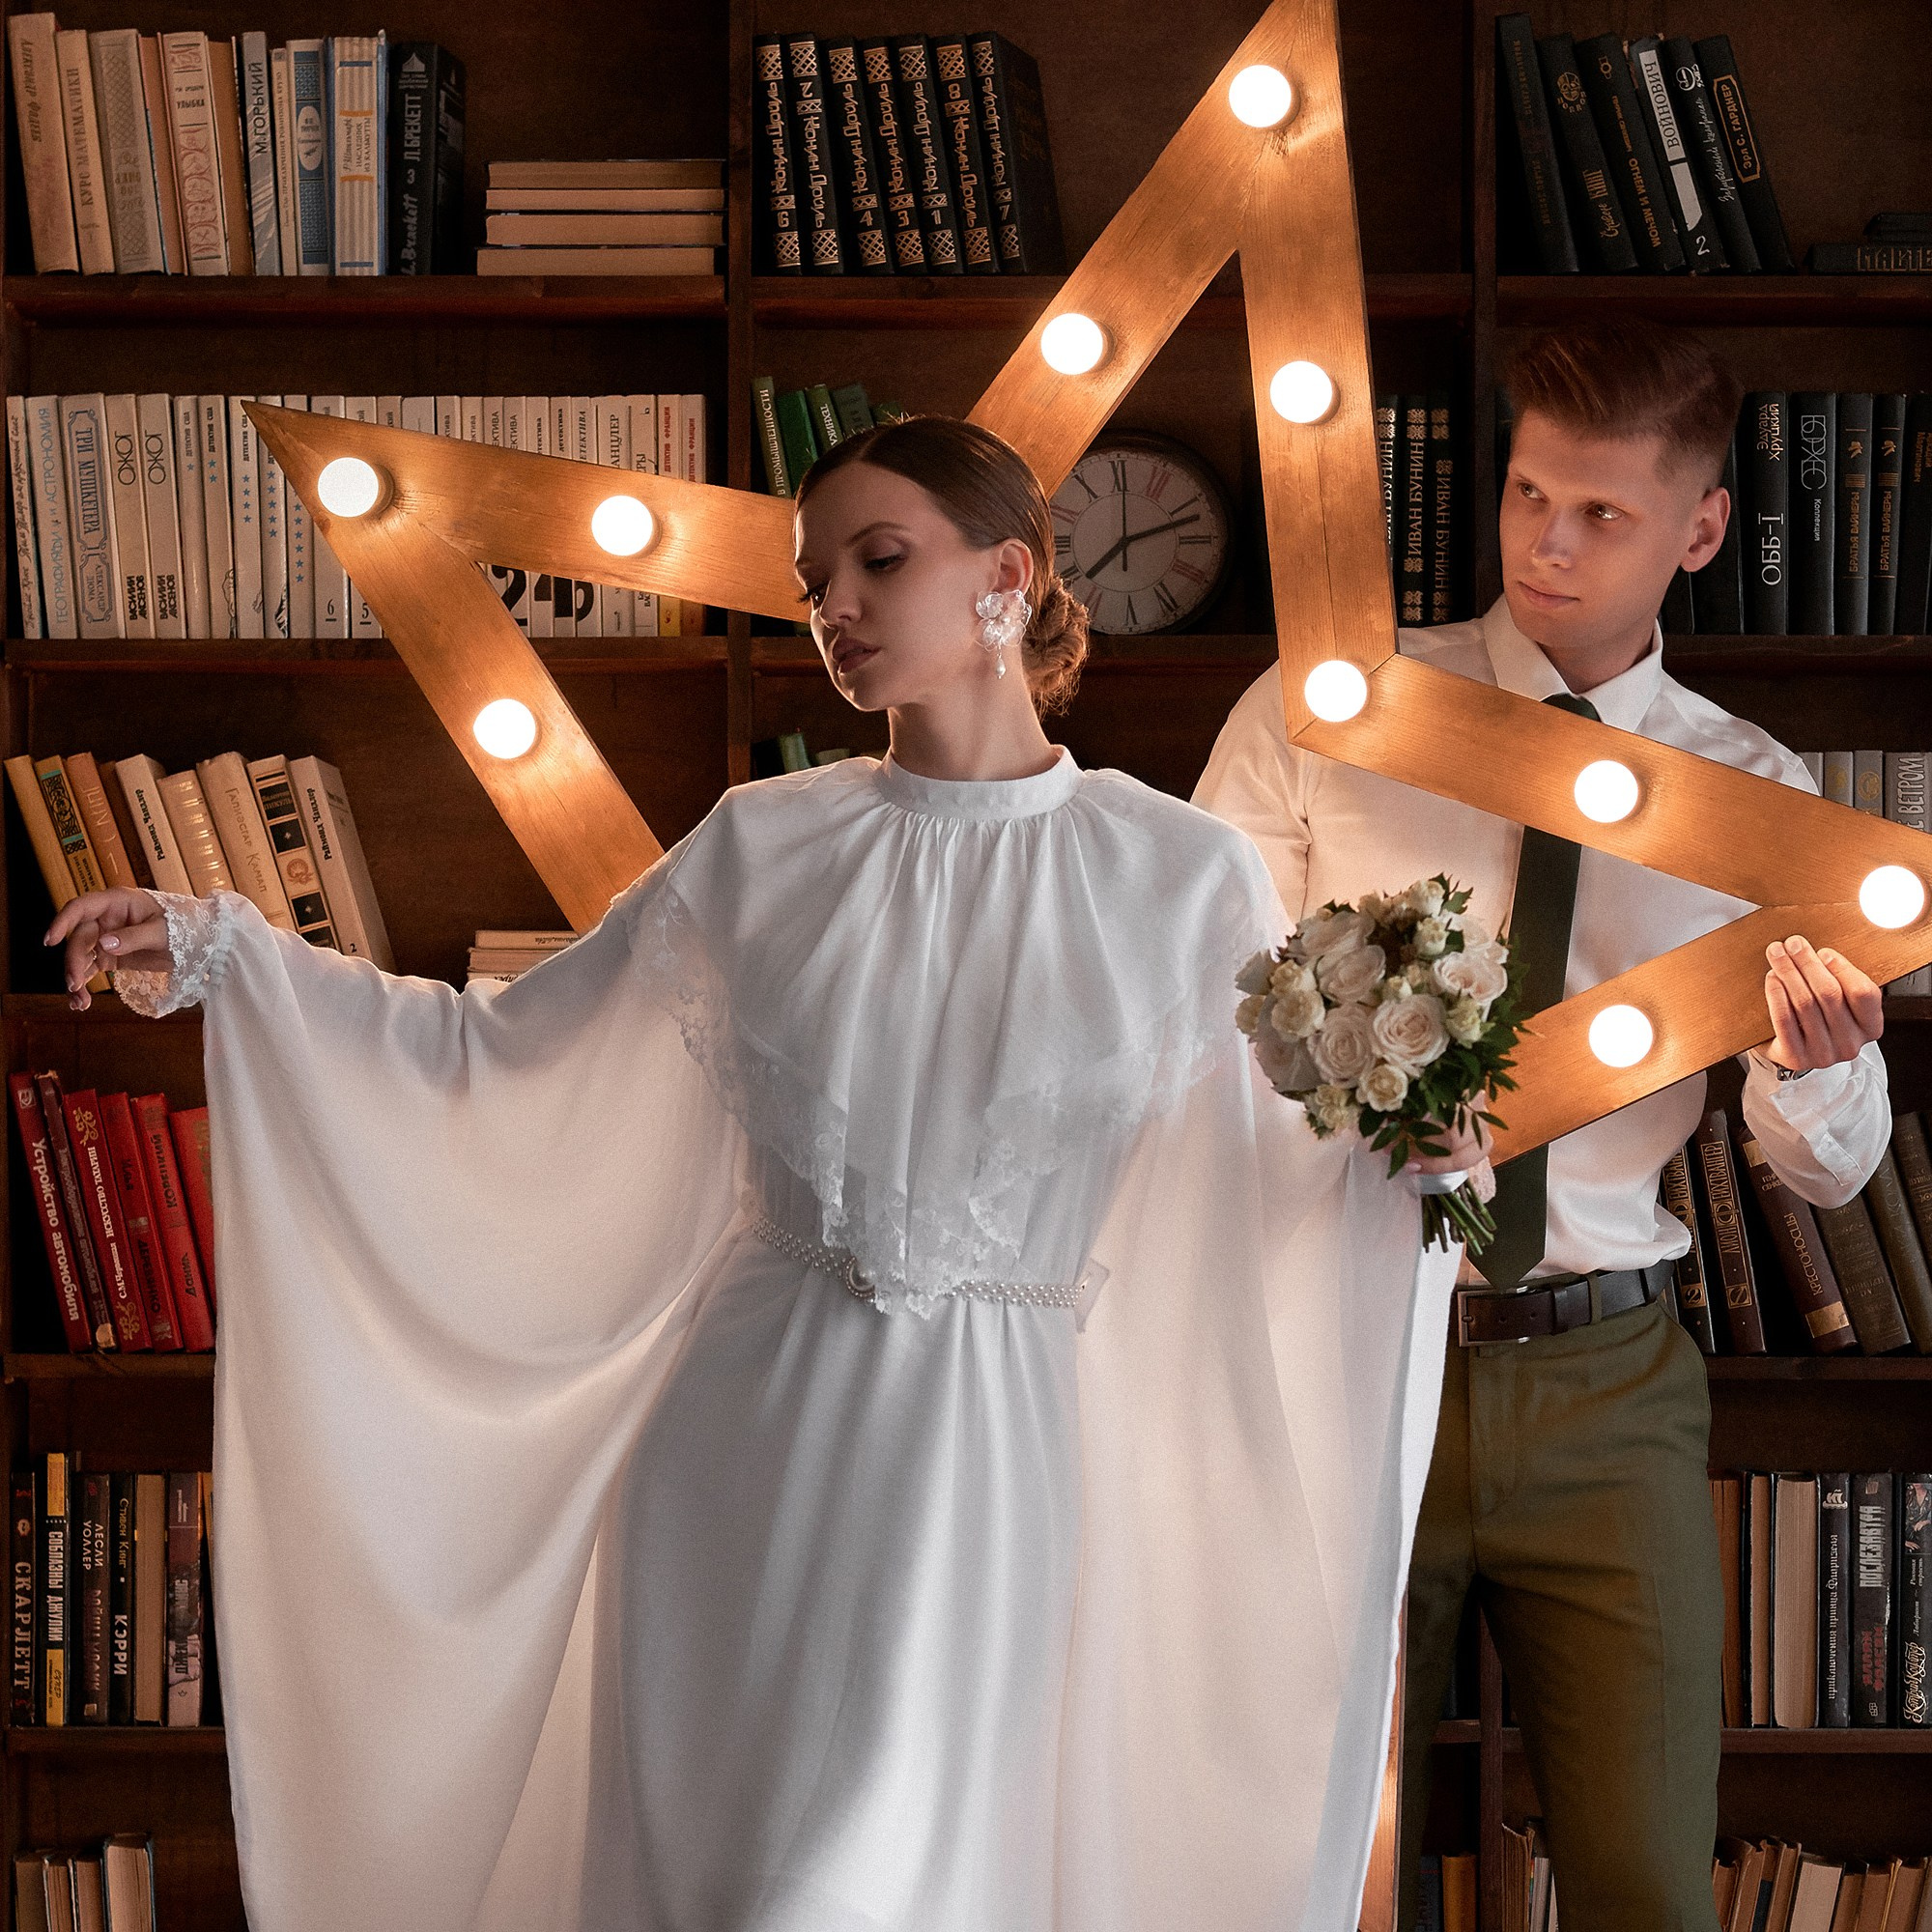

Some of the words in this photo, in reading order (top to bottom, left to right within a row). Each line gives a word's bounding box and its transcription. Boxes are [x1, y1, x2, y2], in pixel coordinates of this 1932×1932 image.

[251, 62, 269, 155] М.ГОРЬКИЙ
[799, 82, 814, 98] 2
[948, 82, 961, 99] 8
[1644, 62, 1679, 148] ВОЙНОВИЧ
[1721, 83, 1744, 132] ГАРДНЕР
[67, 69, 89, 168] МАТЕМАТИКИ
[404, 94, 421, 161] Л.БРЕКЕТТ
[1628, 156, 1646, 195] ОГНЕМ
[1738, 148, 1752, 171] Эрл
[76, 173, 93, 206] КУРС
[1638, 195, 1649, 207] И
[777, 211, 789, 227] 6
[859, 211, 873, 227] 4
[898, 211, 911, 227] 3
[930, 210, 942, 225] 1
[999, 205, 1009, 221] 7
[1641, 206, 1662, 248] МЕЧОМ
[1696, 236, 1710, 256] 2
[75, 428, 94, 453] ТРИ
[610, 413, 622, 469] АНЦЛЕР
[760, 388, 783, 487] ПРОМЫШЛЕННОСТИ
[820, 403, 838, 446] ТЕХНИКА
[1757, 404, 1768, 450] Эдуард
[1768, 403, 1784, 462] Хруцкий
[39, 408, 56, 502] АСТРОНОМИЯ
[1409, 441, 1425, 503] БУНИН
[79, 460, 100, 534] МУШКЕТЕРА
[1435, 475, 1453, 525] ИВАН
[1850, 491, 1861, 533] ВАЙНЕРЫ
[1882, 490, 1892, 533] ВАЙНЕРЫ
[1408, 508, 1423, 557] ИВАН
[1849, 535, 1860, 573] БРАТЬЯ
[1880, 534, 1890, 572] БРАТЬЯ
[1435, 531, 1450, 590] БУНИН
[327, 599, 334, 616] 6
[362, 603, 369, 619] 5
[1897, 757, 1925, 814] ВЕТРОМ
[350, 943, 356, 952] 2
[87, 1146, 104, 1185] ТАТАРИИ
[32, 1137, 59, 1228] Устройство
[51, 1232, 79, 1321] автомобиля
[96, 1184, 114, 1238] ИСКУССТВО
[1784, 1213, 1823, 1295] КРЕСТОНОСЦЫ
[48, 1530, 64, 1589] СОБЛАЗНЫ
[83, 1520, 92, 1572] УОЛЛЕР
[94, 1522, 104, 1568] ЛЕСЛИ
[1859, 1505, 1887, 1587] ПОСЛЕЗАВТРА
[14, 1561, 31, 1690] СКАРЛЕТТ
[47, 1595, 64, 1642] ДЖУЛИИ
[114, 1614, 128, 1676] КЭРРИ
